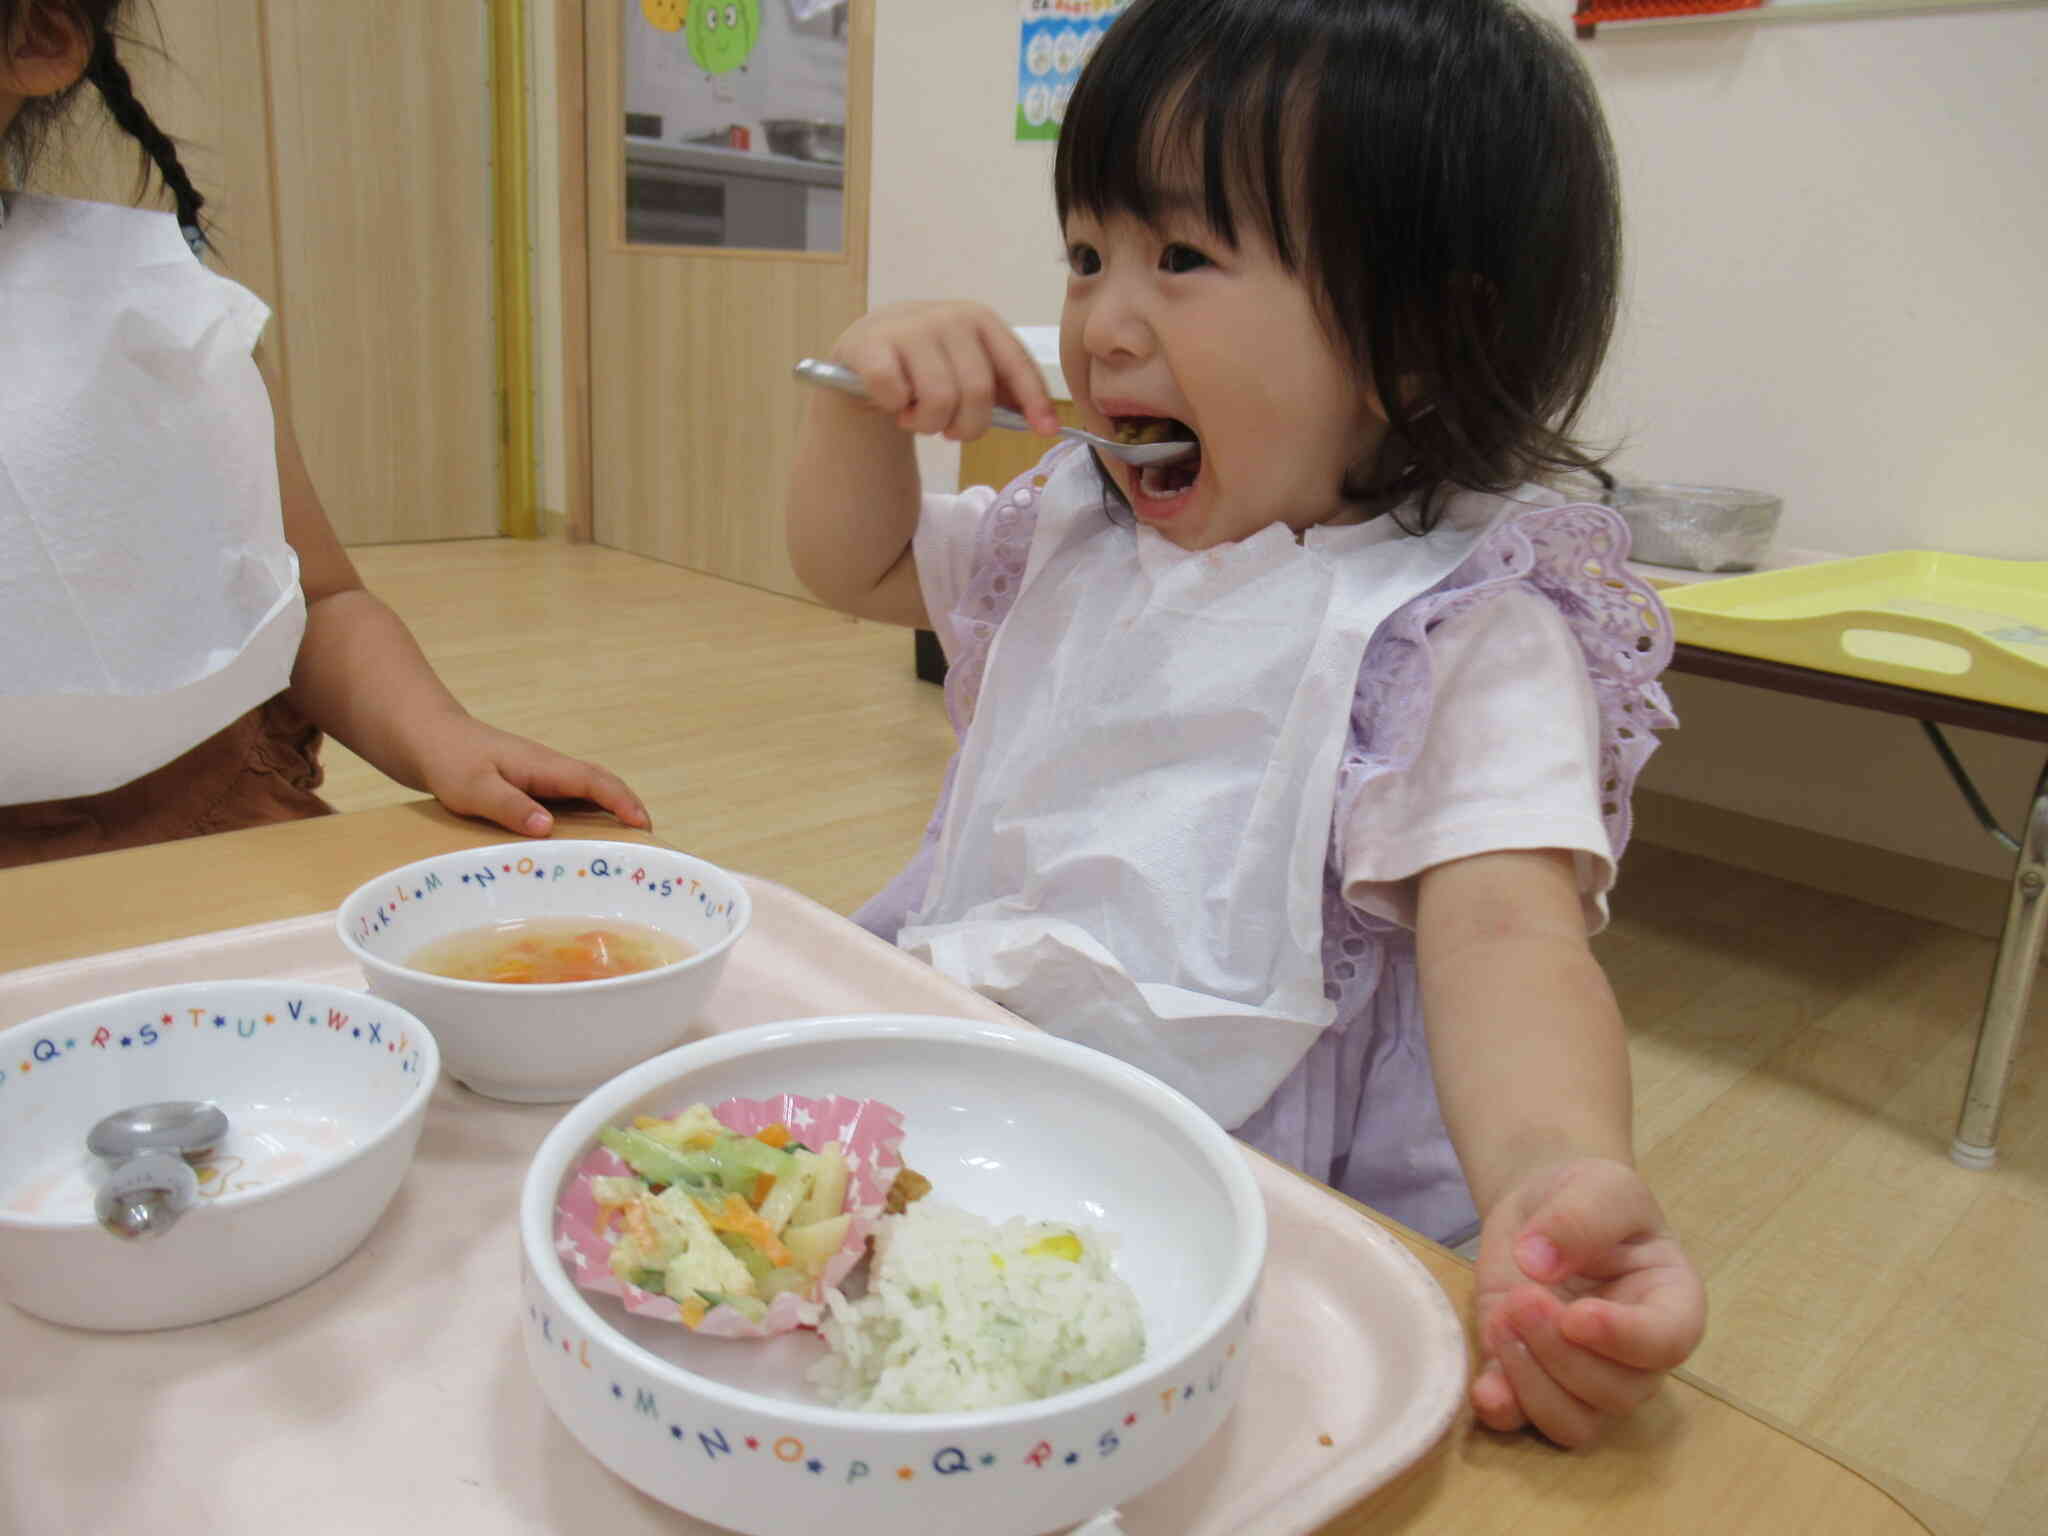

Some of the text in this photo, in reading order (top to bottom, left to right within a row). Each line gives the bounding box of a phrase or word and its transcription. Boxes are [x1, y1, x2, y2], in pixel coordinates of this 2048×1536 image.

[425, 872, 443, 892] M
[475, 867, 496, 887] N
[517, 858, 534, 874] O
[552, 866, 565, 881] P
[592, 859, 610, 877] Q
[631, 868, 645, 885] R
[660, 880, 672, 896] S
[34, 1040, 60, 1061] Q
[91, 1027, 110, 1048] R
[139, 1024, 158, 1045] S
[188, 1009, 205, 1027] T
[238, 1020, 255, 1037] U
[288, 1000, 303, 1020] V
[327, 1009, 348, 1030] W
[369, 1023, 381, 1043] X
[635, 1388, 659, 1419] M
[698, 1428, 731, 1459] N
[773, 1436, 804, 1462] O
[846, 1460, 870, 1484] P
[933, 1447, 972, 1475] Q
[1025, 1440, 1053, 1468] R
[1098, 1429, 1119, 1457] S
